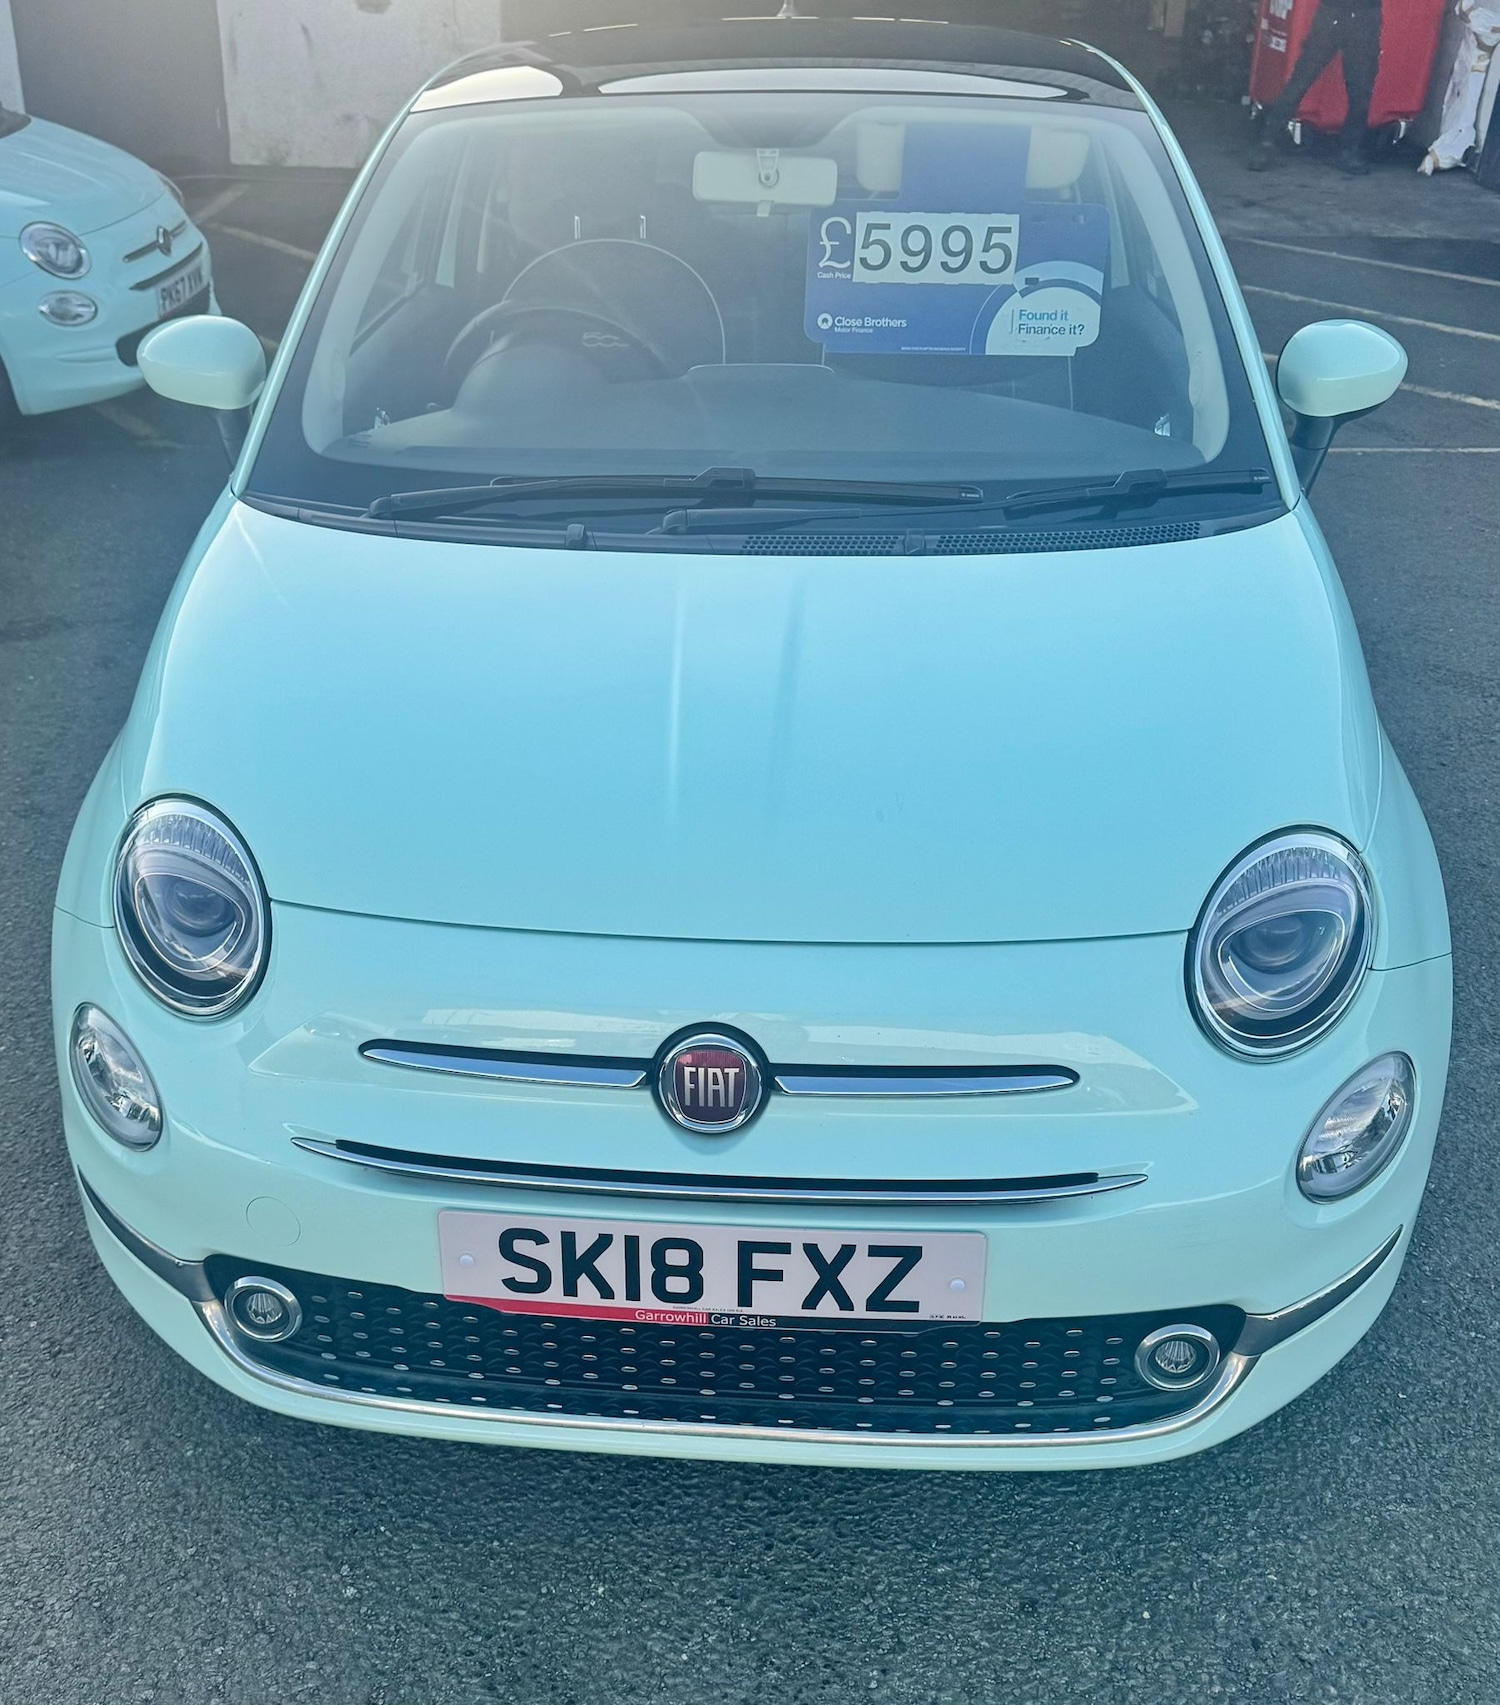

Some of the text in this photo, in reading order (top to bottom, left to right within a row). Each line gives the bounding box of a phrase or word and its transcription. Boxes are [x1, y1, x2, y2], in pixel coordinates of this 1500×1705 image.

[817, 271, 852, 279] Cash Price
[1018, 309, 1069, 321] Found it
[834, 316, 908, 328] Close Brothers
[851, 326, 874, 334] Finance
[1018, 323, 1085, 335] Finance it?
[683, 1066, 740, 1108] FIAT
[498, 1227, 923, 1313] SK18 FXZ
[635, 1309, 777, 1328] Garrowhill Car Sales
